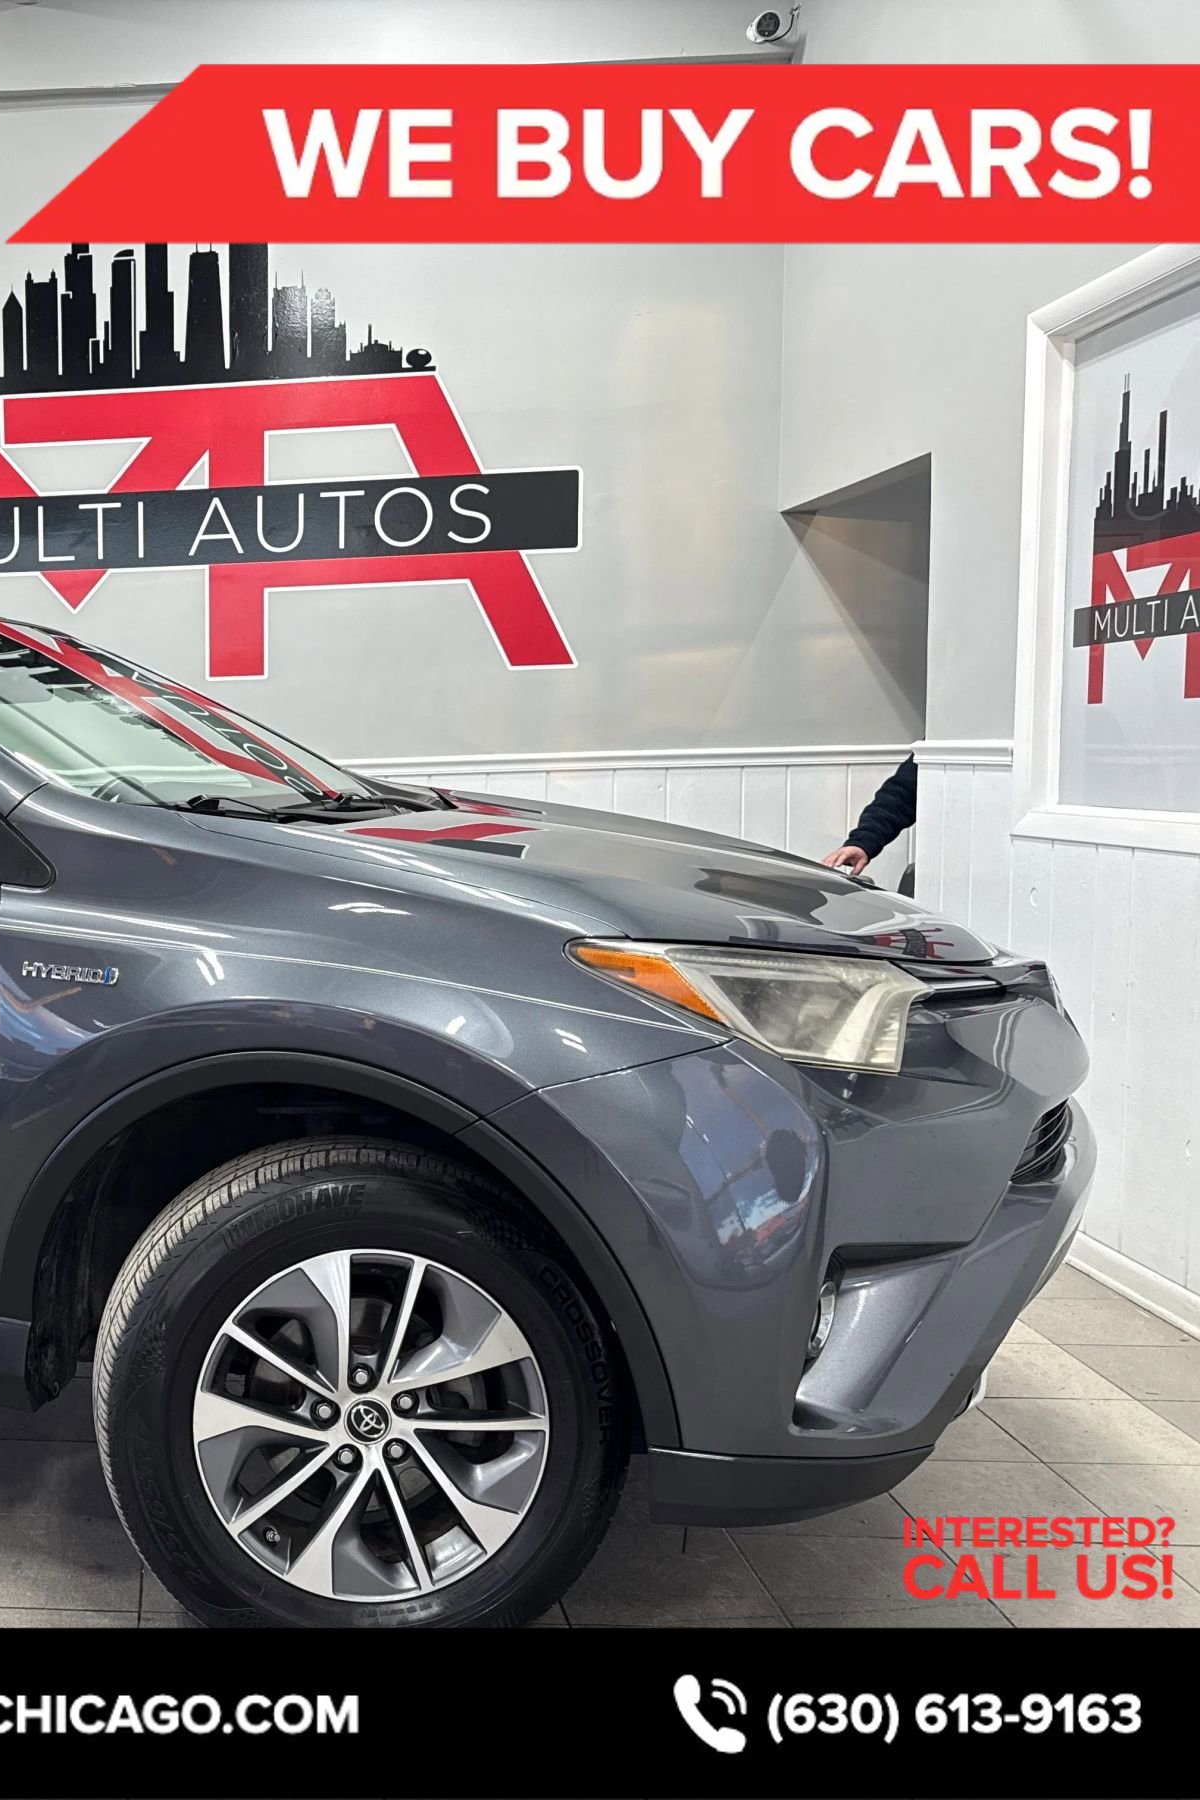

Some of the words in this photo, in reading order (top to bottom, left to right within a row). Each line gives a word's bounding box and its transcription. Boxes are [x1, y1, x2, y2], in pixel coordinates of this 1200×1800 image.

[188, 483, 493, 557] AUTOS
[1093, 598, 1169, 641] MULTI
[21, 960, 104, 985] HYBRID
[536, 1263, 616, 1447] CROSSOVER
